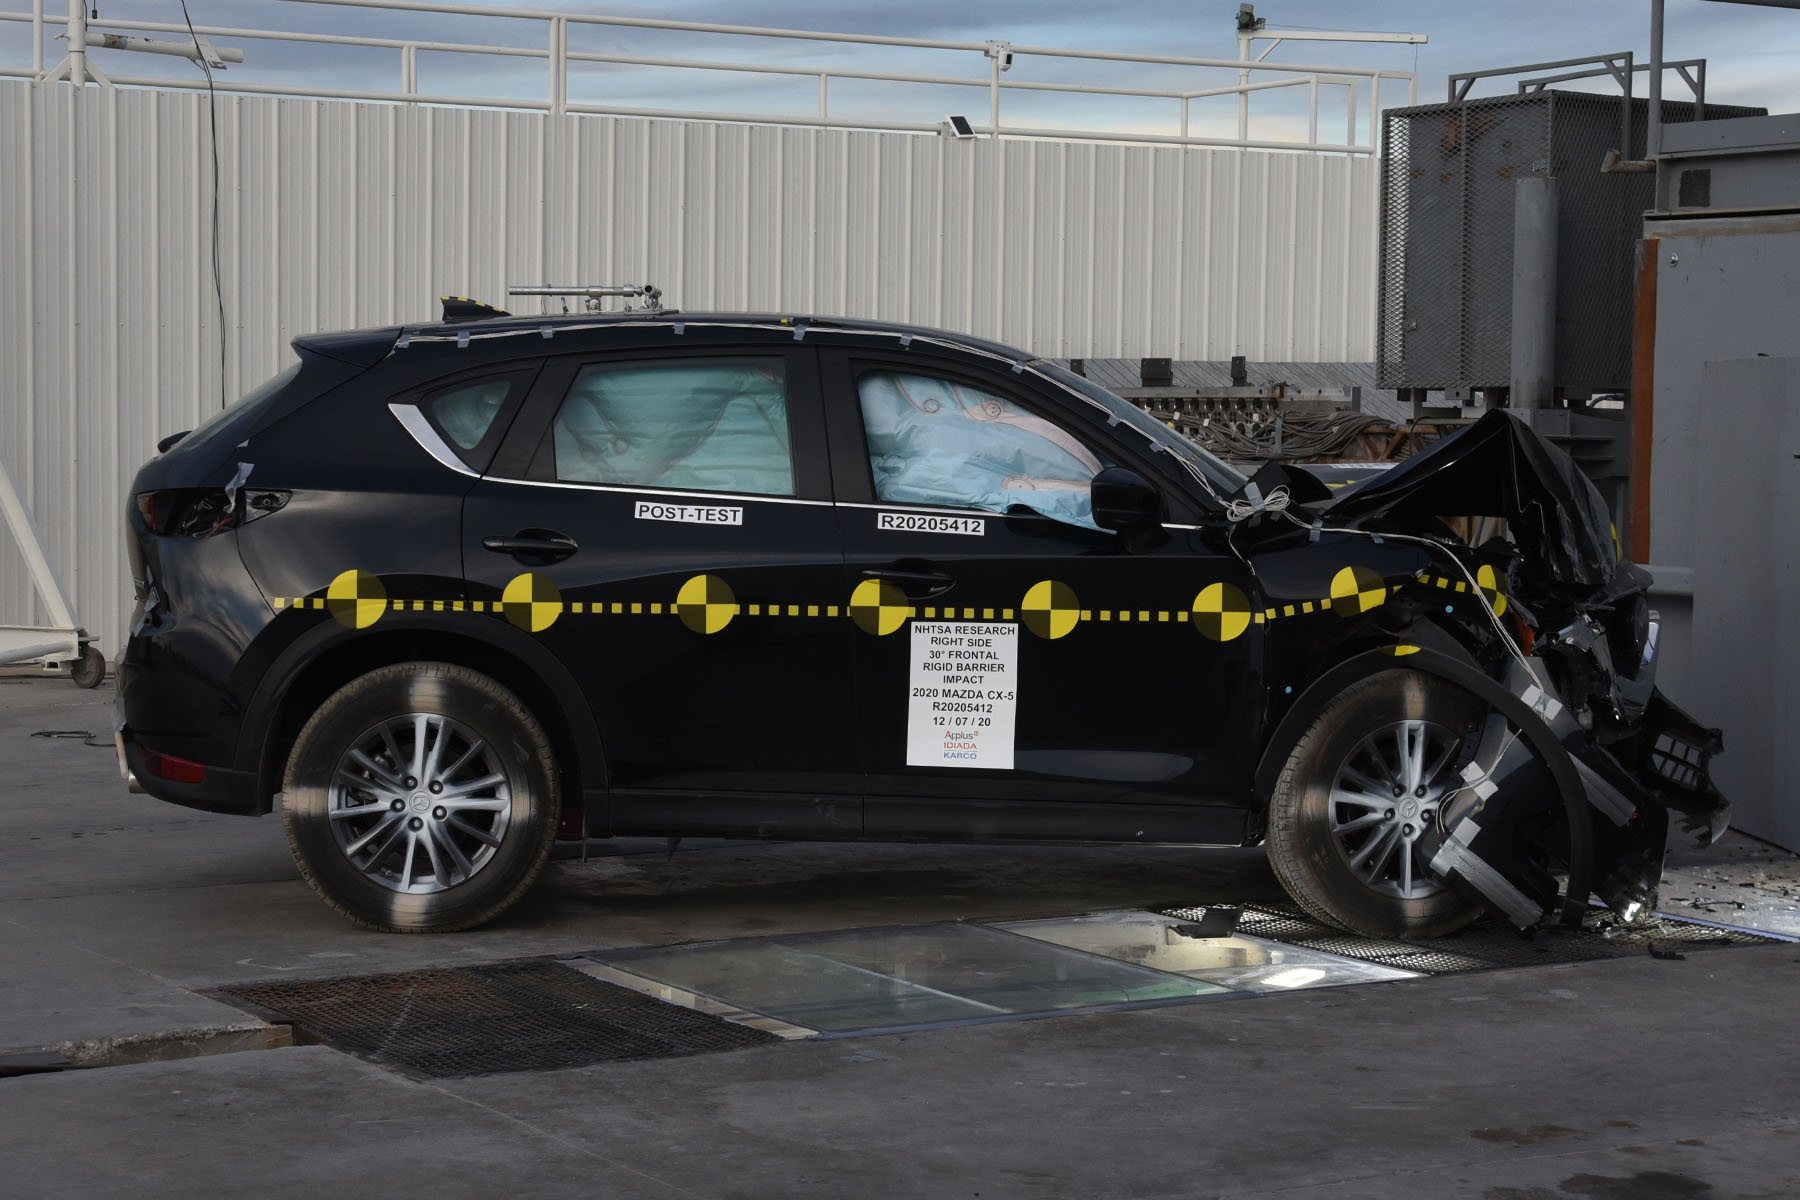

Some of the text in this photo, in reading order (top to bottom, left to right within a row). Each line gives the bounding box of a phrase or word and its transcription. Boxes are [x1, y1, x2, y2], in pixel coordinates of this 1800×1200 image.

[639, 505, 740, 522] POST-TEST
[881, 515, 981, 532] R20205412
[914, 625, 1015, 636] NHTSA RESEARCH
[931, 637, 992, 648] RIGHT SIDE
[929, 650, 1000, 660] 30° FRONTAL
[923, 662, 1005, 672] RIGID BARRIER
[943, 675, 984, 684] IMPACT
[912, 687, 1014, 700] 2020 MAZDA CX-5
[932, 702, 993, 713] R20205412
[933, 716, 945, 726] 12
[955, 717, 968, 726] 07
[978, 717, 991, 727] 20
[943, 742, 977, 750] IDIADA
[943, 751, 978, 760] KARCO
